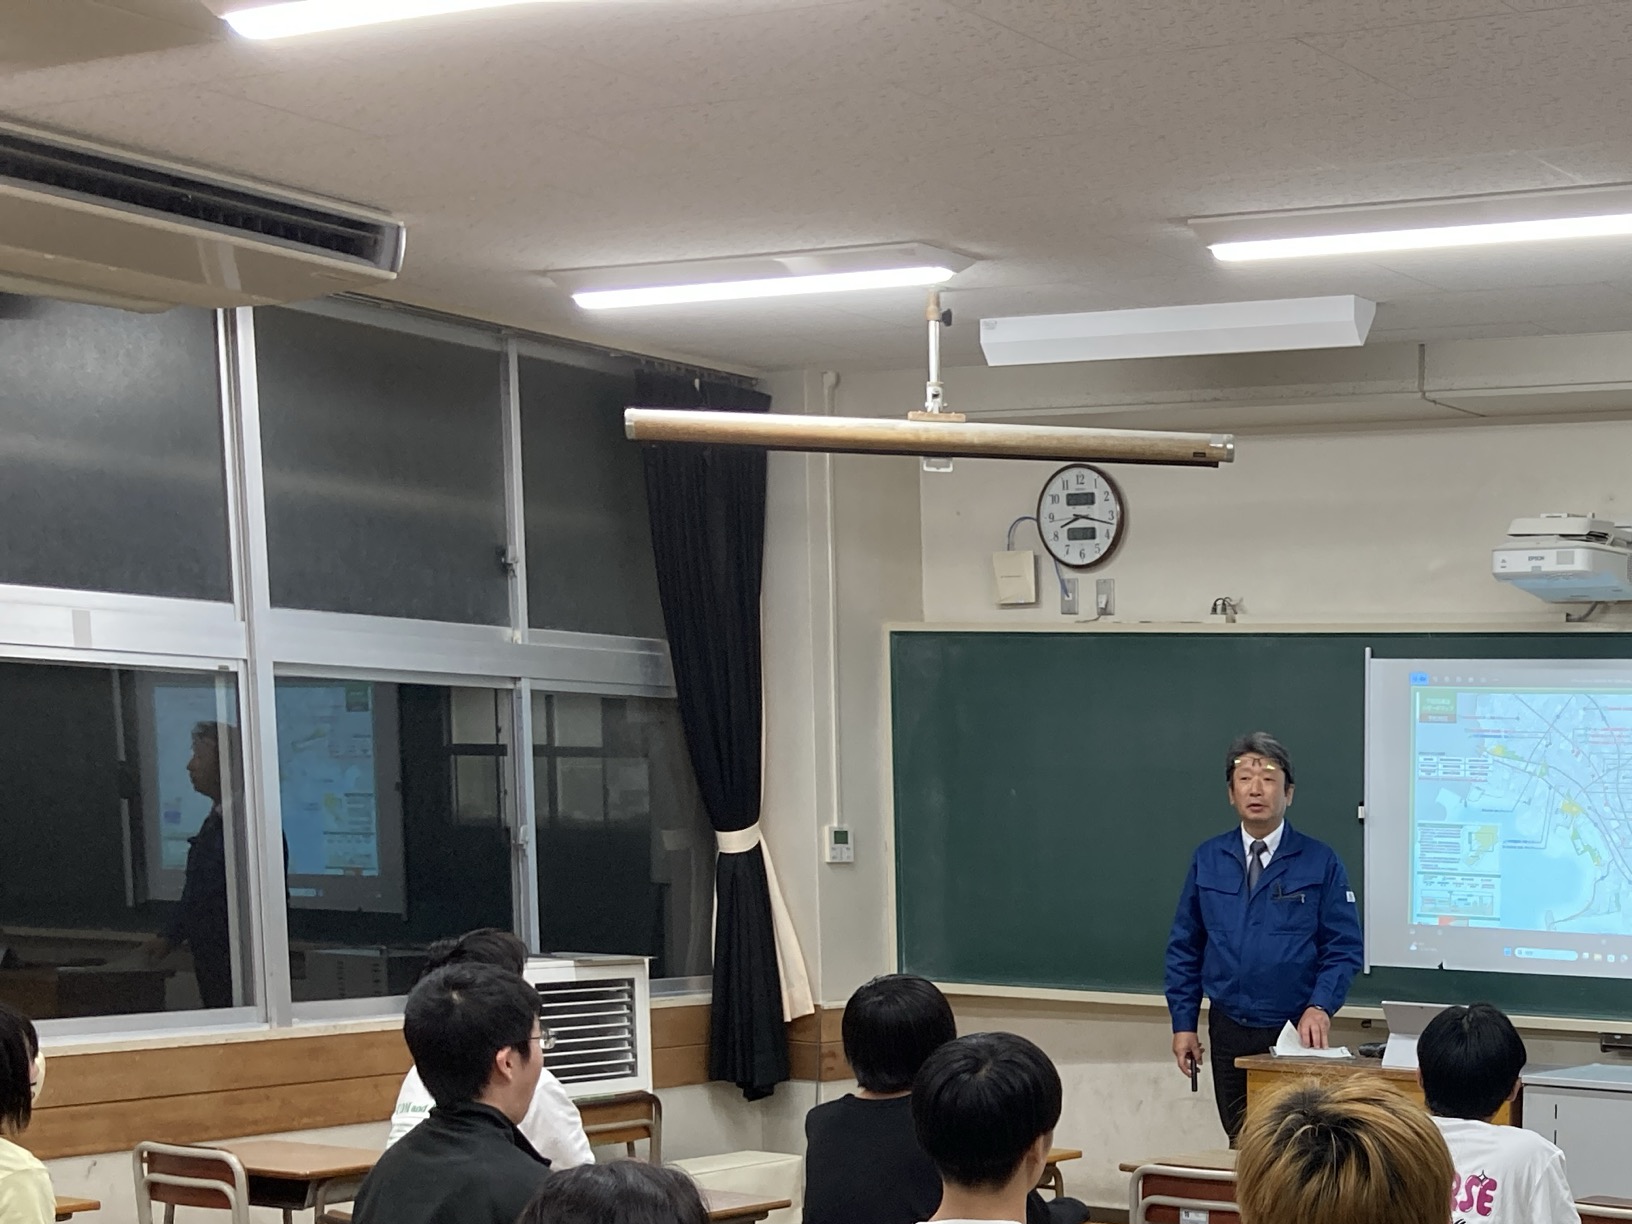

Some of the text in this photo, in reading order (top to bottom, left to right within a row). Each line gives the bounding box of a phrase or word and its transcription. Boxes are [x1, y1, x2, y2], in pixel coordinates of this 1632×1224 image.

[1075, 474, 1085, 485] 12
[1094, 478, 1098, 489] 1
[1062, 480, 1069, 491] 11
[1050, 494, 1060, 504] 10
[1103, 491, 1110, 501] 2
[1048, 513, 1055, 523] 9
[1108, 511, 1115, 521] 3
[1053, 530, 1059, 541] 8
[1104, 529, 1110, 540] 4
[1064, 545, 1070, 555] 7
[1079, 549, 1085, 560] 6
[1094, 545, 1100, 554] 5
